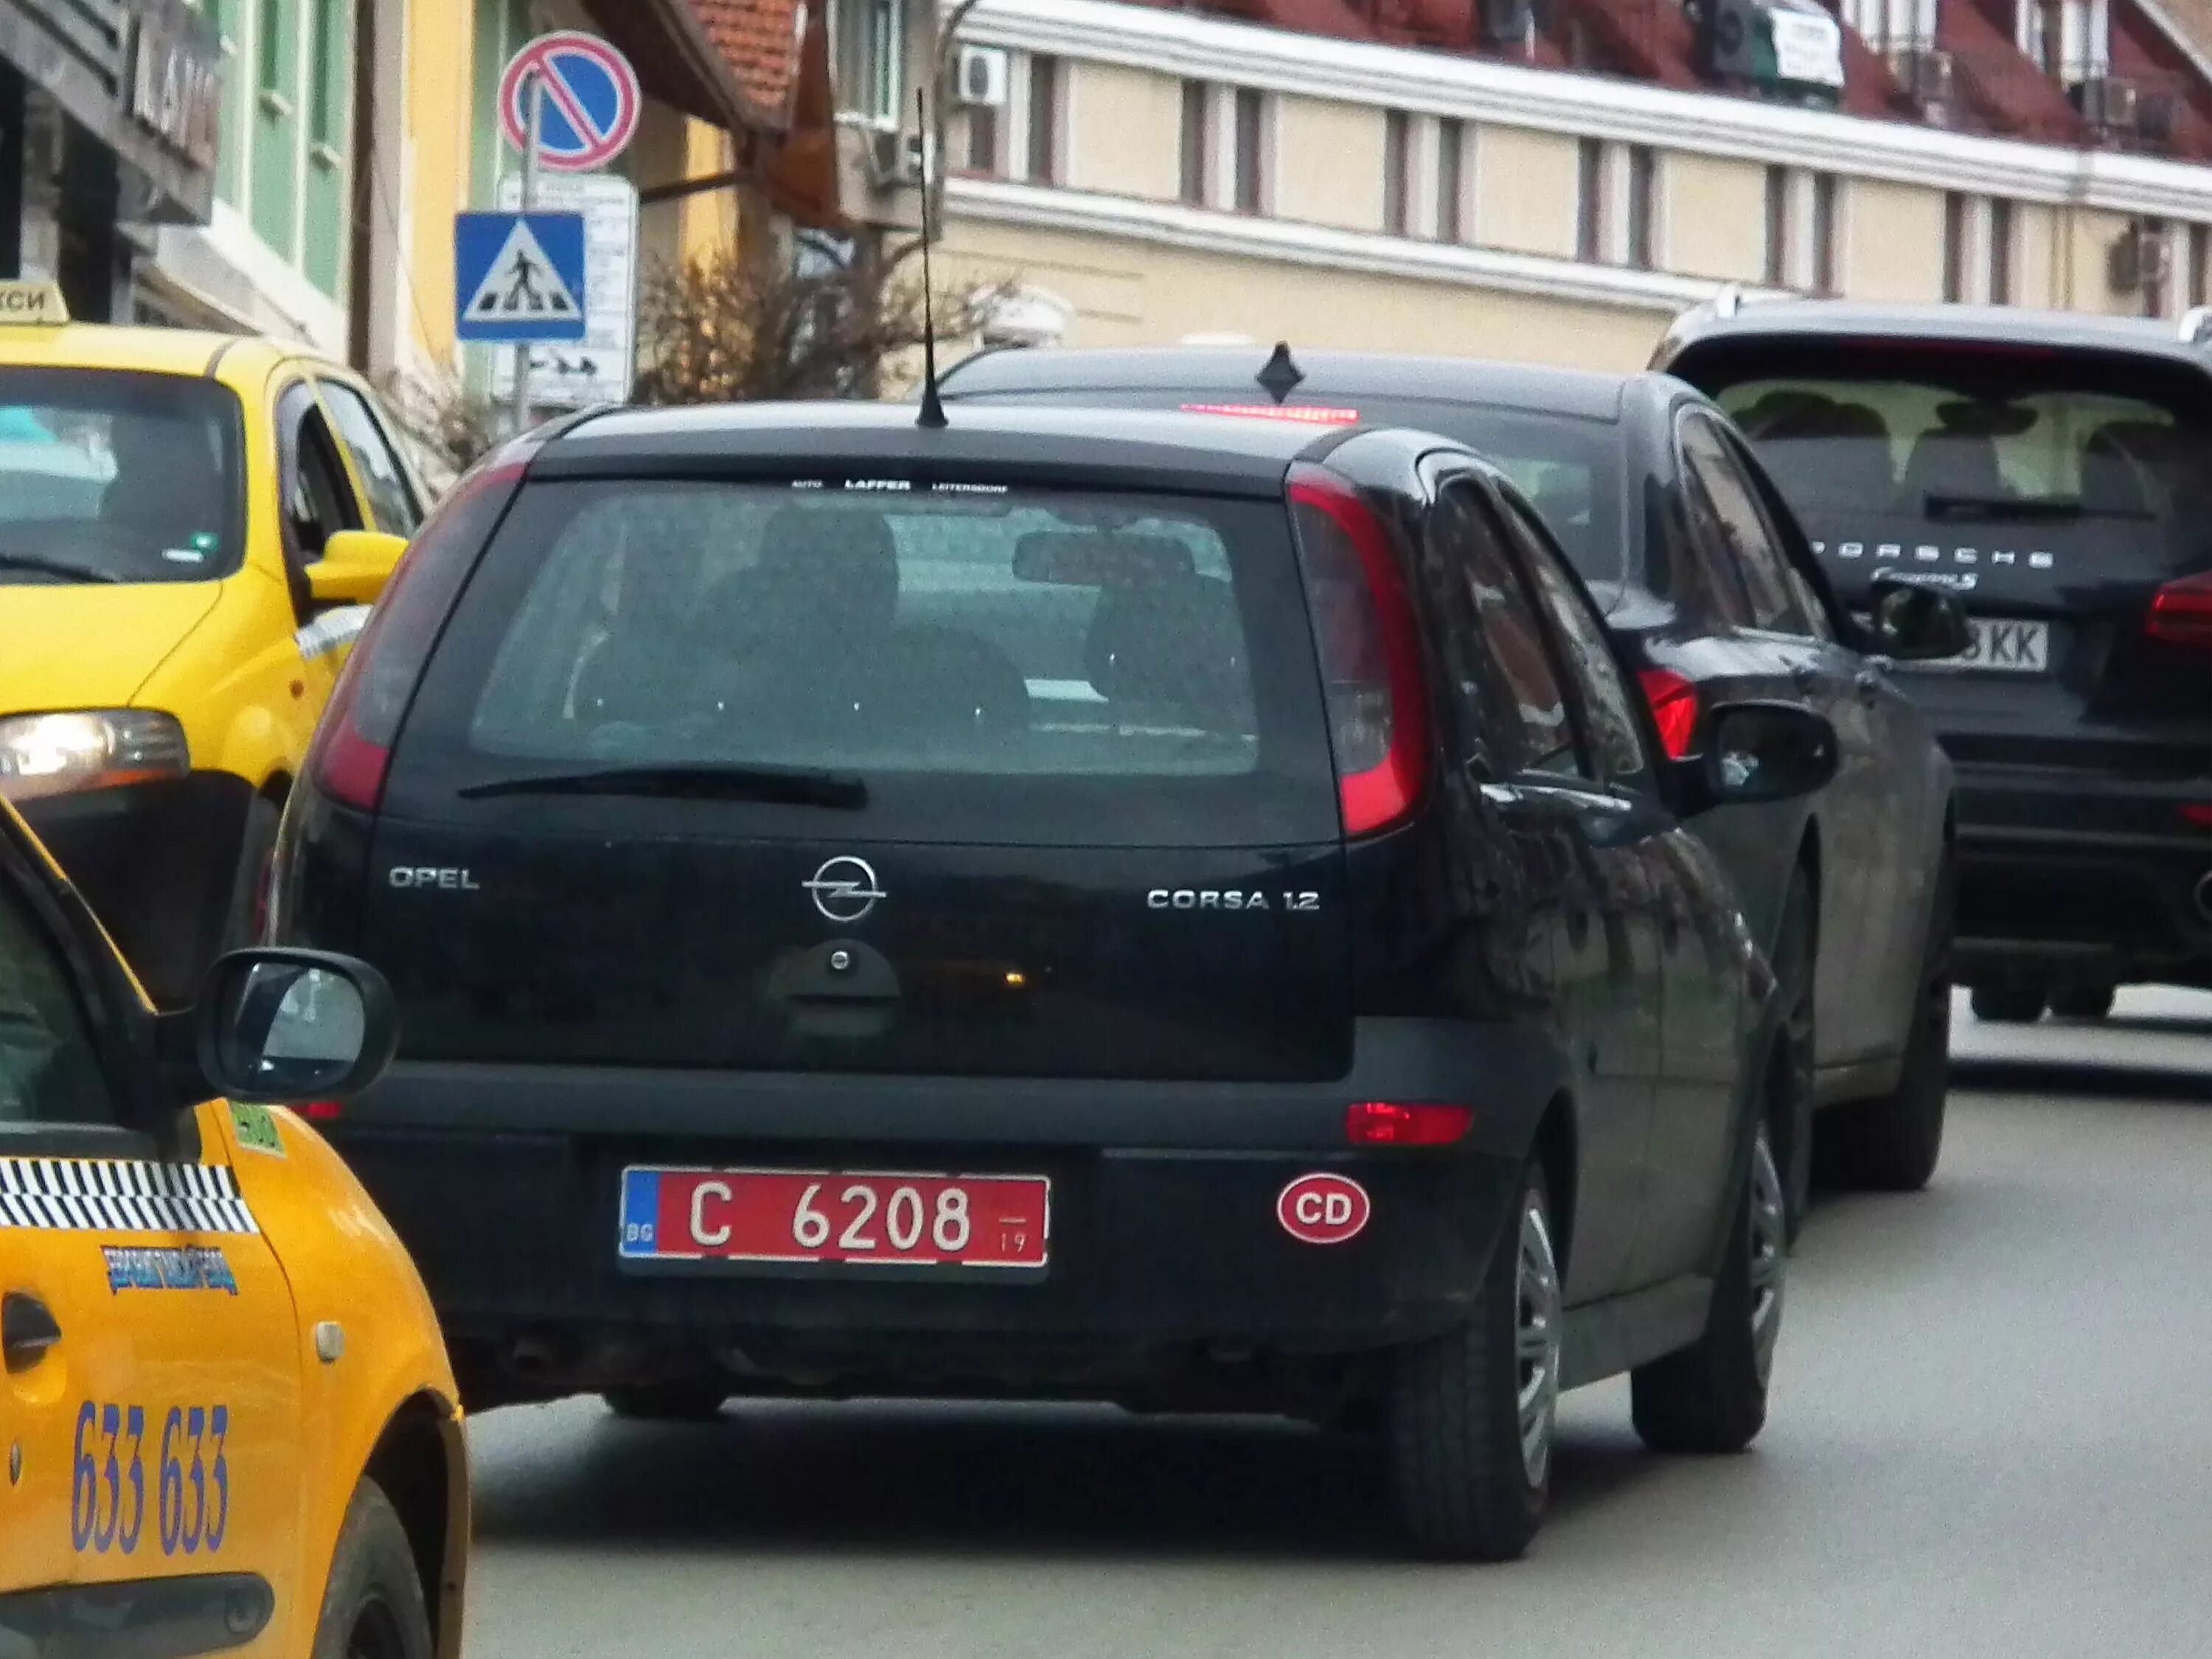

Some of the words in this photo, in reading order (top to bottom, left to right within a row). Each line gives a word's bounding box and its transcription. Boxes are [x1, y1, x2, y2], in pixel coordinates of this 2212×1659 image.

[844, 479, 911, 490] LAFFER
[389, 866, 480, 889] OPEL
[1147, 889, 1270, 910] CORSA
[689, 1181, 733, 1246] C
[793, 1184, 971, 1251] 6208
[1295, 1192, 1352, 1225] CD
[626, 1222, 653, 1242] BG
[1001, 1232, 1026, 1252] 19
[72, 1399, 145, 1555] 633
[159, 1405, 228, 1557] 633
